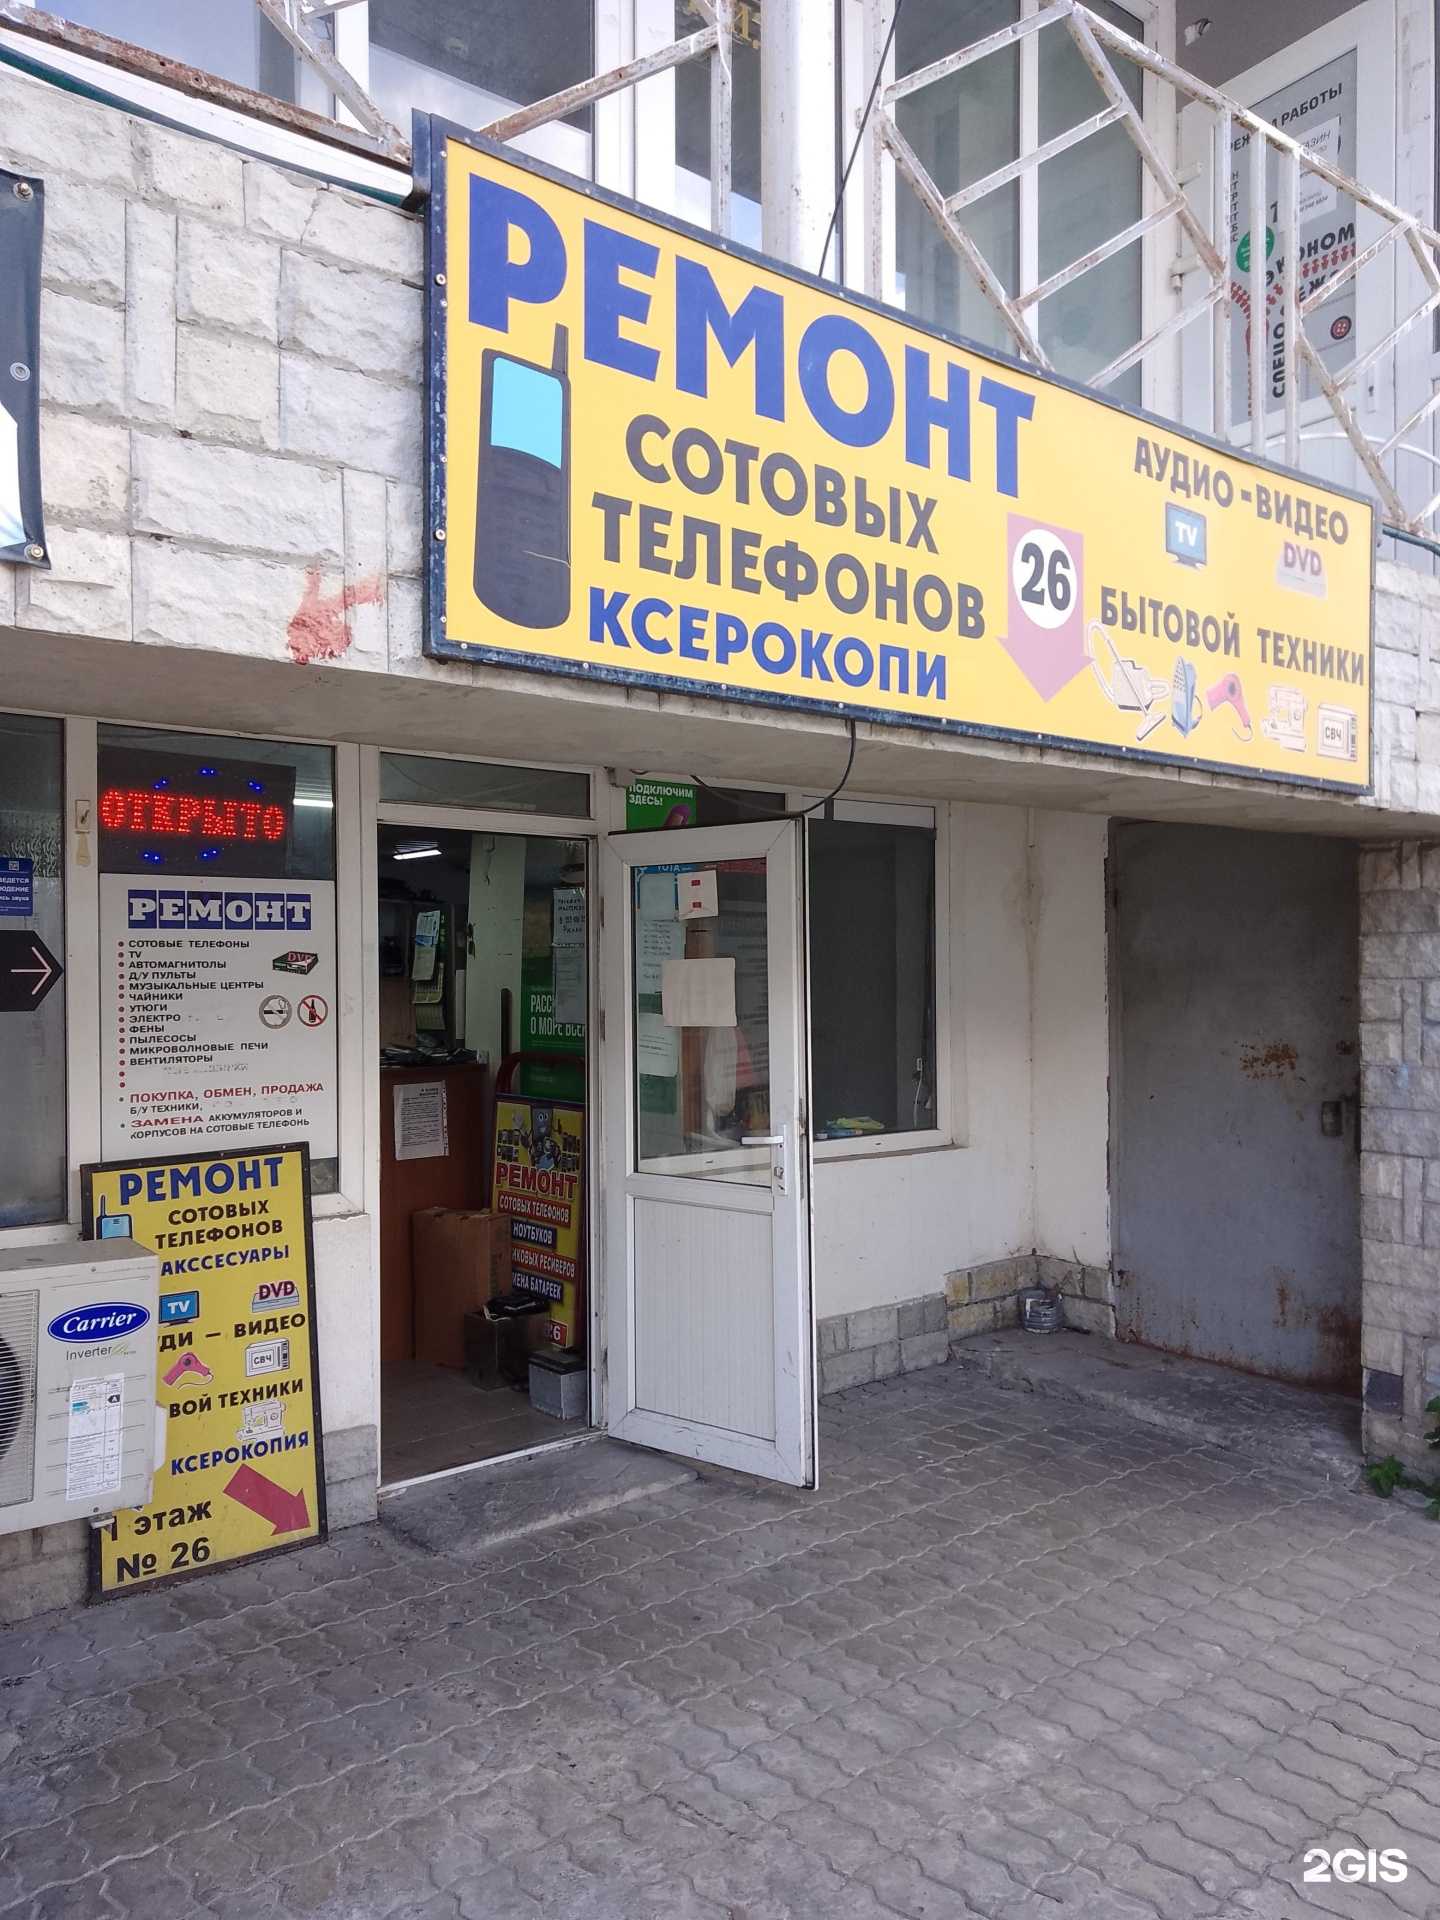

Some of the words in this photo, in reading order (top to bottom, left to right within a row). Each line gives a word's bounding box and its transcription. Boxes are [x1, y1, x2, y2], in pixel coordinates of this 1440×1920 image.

[1281, 83, 1342, 126] РАБОТЫ
[469, 174, 1036, 498] РЕМОНТ
[626, 414, 938, 554] СОТОВЫХ
[1176, 521, 1198, 547] TV
[592, 492, 985, 639] ТЕЛЕФОНОВ
[1283, 541, 1322, 576] DVD
[1021, 542, 1072, 611] 26
[589, 586, 946, 700] КСЕРОКОПИ
[1101, 586, 1241, 657] БЫТОВОЙ
[1257, 628, 1365, 686] ТЕХНИКИ
[1325, 726, 1342, 741] СВЧ
[628, 794, 663, 806] ЗДЕСЬ!
[629, 783, 693, 798] ПОДКЛЮЧИМ
[101, 790, 285, 840] ОТКРЫТО
[129, 898, 311, 923] РЕМОНТ
[129, 940, 183, 948] СОТОВЫЕ
[189, 940, 250, 949] ТЕЛЕФОНЫ
[129, 951, 142, 959] TV
[129, 961, 226, 969] АВТОМАГНИТОЛЫ
[129, 972, 149, 981] Д/У
[152, 971, 196, 980] ПУЛЬТЫ
[129, 981, 217, 990] МУЗЫКАЛЬНЫЕ
[221, 981, 264, 991] ЦЕНТРЫ
[129, 991, 183, 1001] ЧАЙНИКИ
[129, 1014, 181, 1023] ЭЛЕКТРО
[130, 1003, 168, 1013] УТЮГИ
[129, 1025, 165, 1033] ФЕНЫ
[129, 1034, 197, 1044] ПЫЛЕСОСЫ
[129, 1043, 235, 1055] МИКРОВОЛНОВЫЕ
[241, 1042, 268, 1050] ПЕЧИ
[130, 1055, 213, 1066] ВЕНТИЛЯТОРЫ
[130, 1091, 199, 1103] ПОКУПКА,
[203, 1087, 257, 1098] ОБМЕН,
[261, 1083, 324, 1095] ПРОДАЖА
[130, 1106, 148, 1117] Б/У
[131, 1116, 204, 1128] ЗАМЕНА
[208, 1110, 293, 1122] АККУМУЛЯТОРОВ
[190, 1127, 203, 1135] НА
[206, 1123, 254, 1133] СОТОВЫЕ
[119, 1157, 283, 1206] РЕМОНТ
[496, 1162, 578, 1199] РЕМОНТ
[168, 1200, 269, 1226] СОТОВЫХ
[500, 1195, 531, 1213] СОТОВЫХ
[533, 1200, 569, 1223] ТЕЛЕФОНОВ
[155, 1220, 283, 1250] ТЕЛЕФОНОВ
[513, 1221, 553, 1244] НОУТБУКОВ
[161, 1245, 289, 1276] АКССЕСУАРЫ
[540, 1254, 575, 1278] РЕСИВЕРОВ
[258, 1281, 295, 1300] DVD
[530, 1277, 561, 1299] БАТАРЕЕК
[168, 1300, 190, 1314] TV
[63, 1311, 137, 1334] Carrier
[158, 1332, 193, 1352] ДИ
[234, 1313, 306, 1338] ВИДЕО
[66, 1345, 113, 1361] Inverter
[253, 1354, 272, 1365] СВЧ
[218, 1378, 304, 1408] ТЕХНИКИ
[171, 1431, 309, 1476] КСЕРОКОПИЯ
[134, 1501, 213, 1535] этаж
[116, 1553, 157, 1583] №
[170, 1537, 210, 1569] 26
